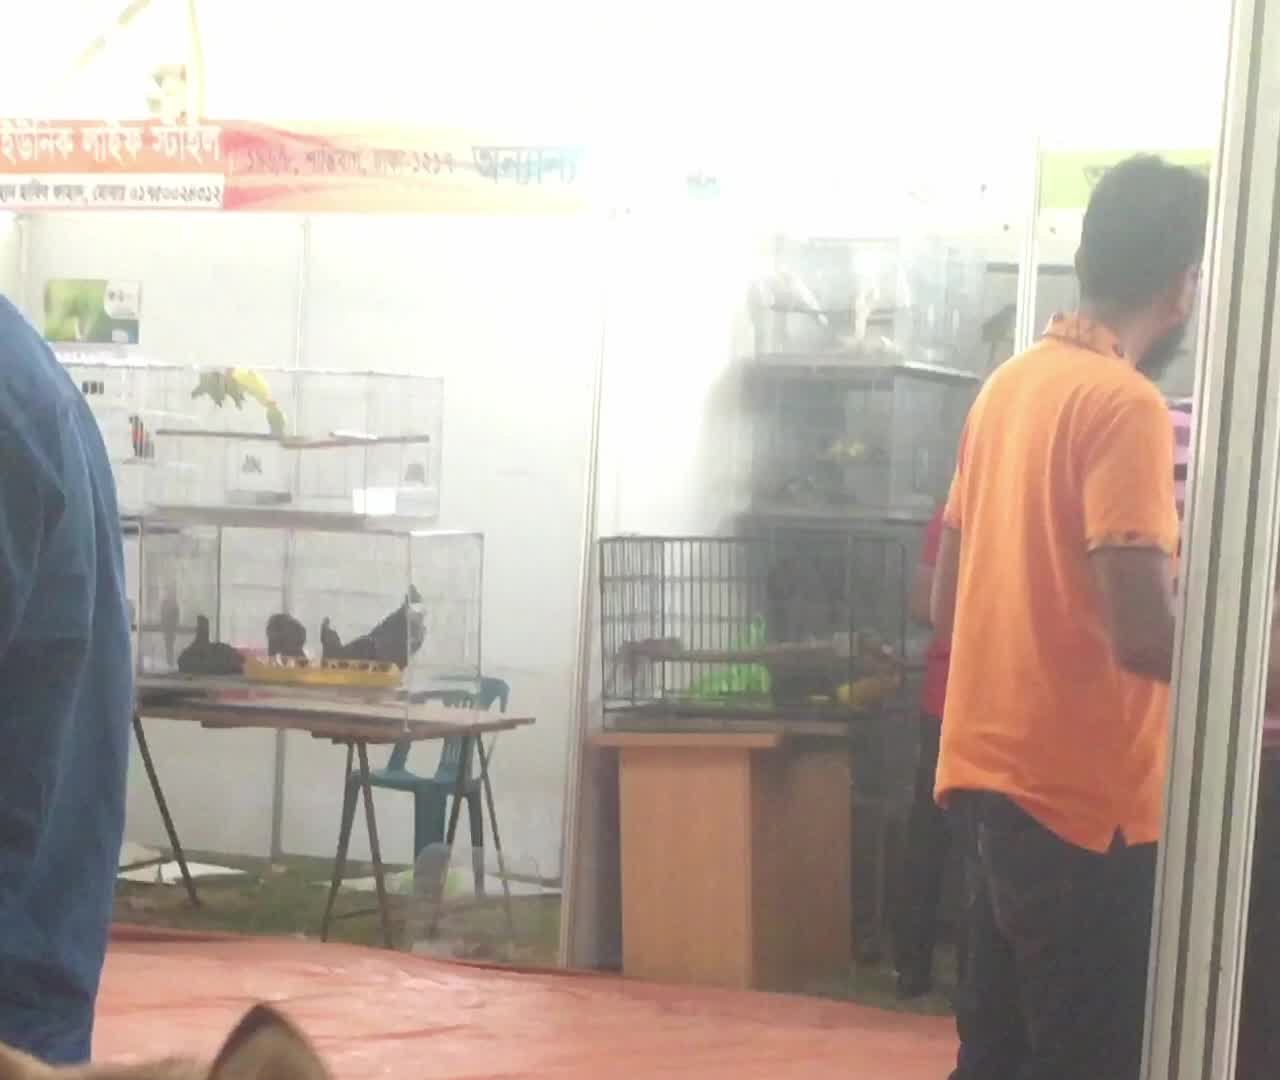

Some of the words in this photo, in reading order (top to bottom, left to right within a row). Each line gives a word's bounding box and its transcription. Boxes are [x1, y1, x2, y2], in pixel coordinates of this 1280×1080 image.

[0, 118, 74, 167] ইউনিক
[80, 116, 142, 167] লাইফ
[150, 118, 223, 166] স্টাইল
